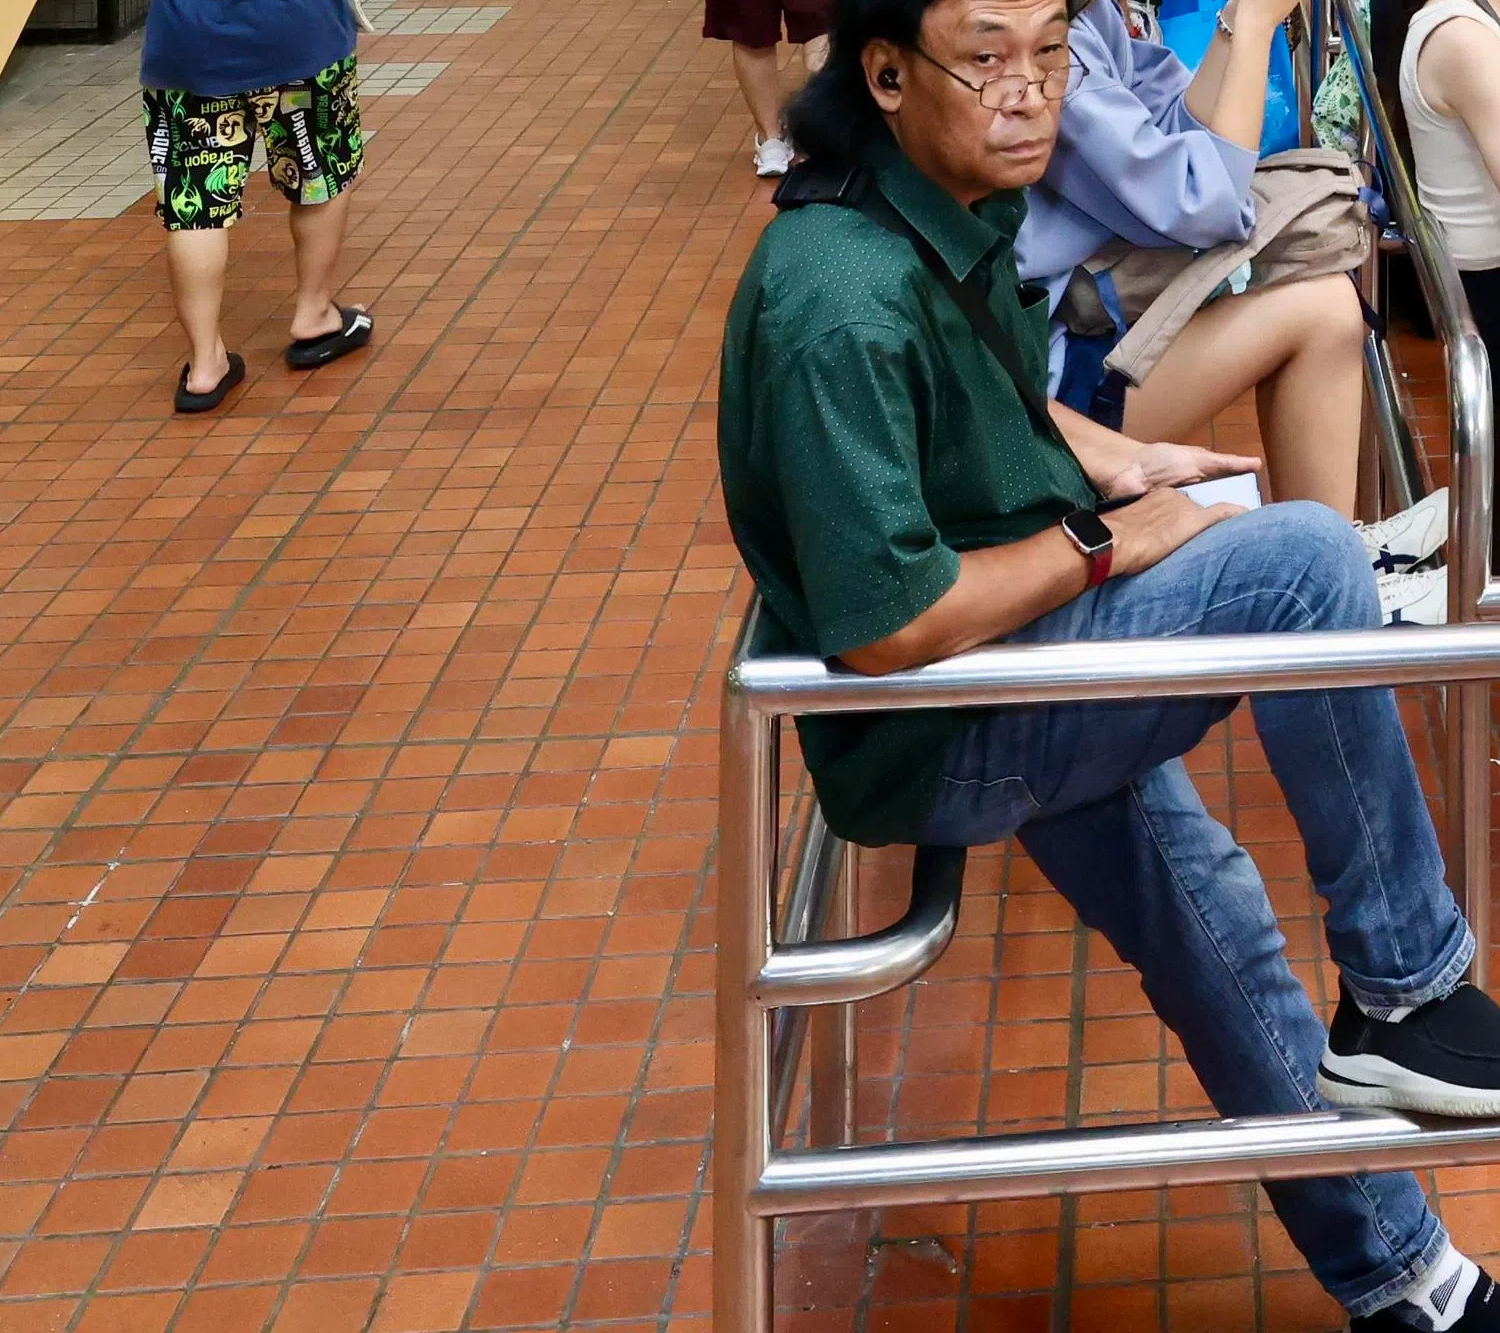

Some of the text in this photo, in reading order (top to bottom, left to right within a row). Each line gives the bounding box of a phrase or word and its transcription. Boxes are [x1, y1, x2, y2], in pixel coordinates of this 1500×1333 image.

[180, 137, 222, 152] CLUB
[290, 110, 318, 171] DRAGONS
[184, 150, 234, 167] Dragon
